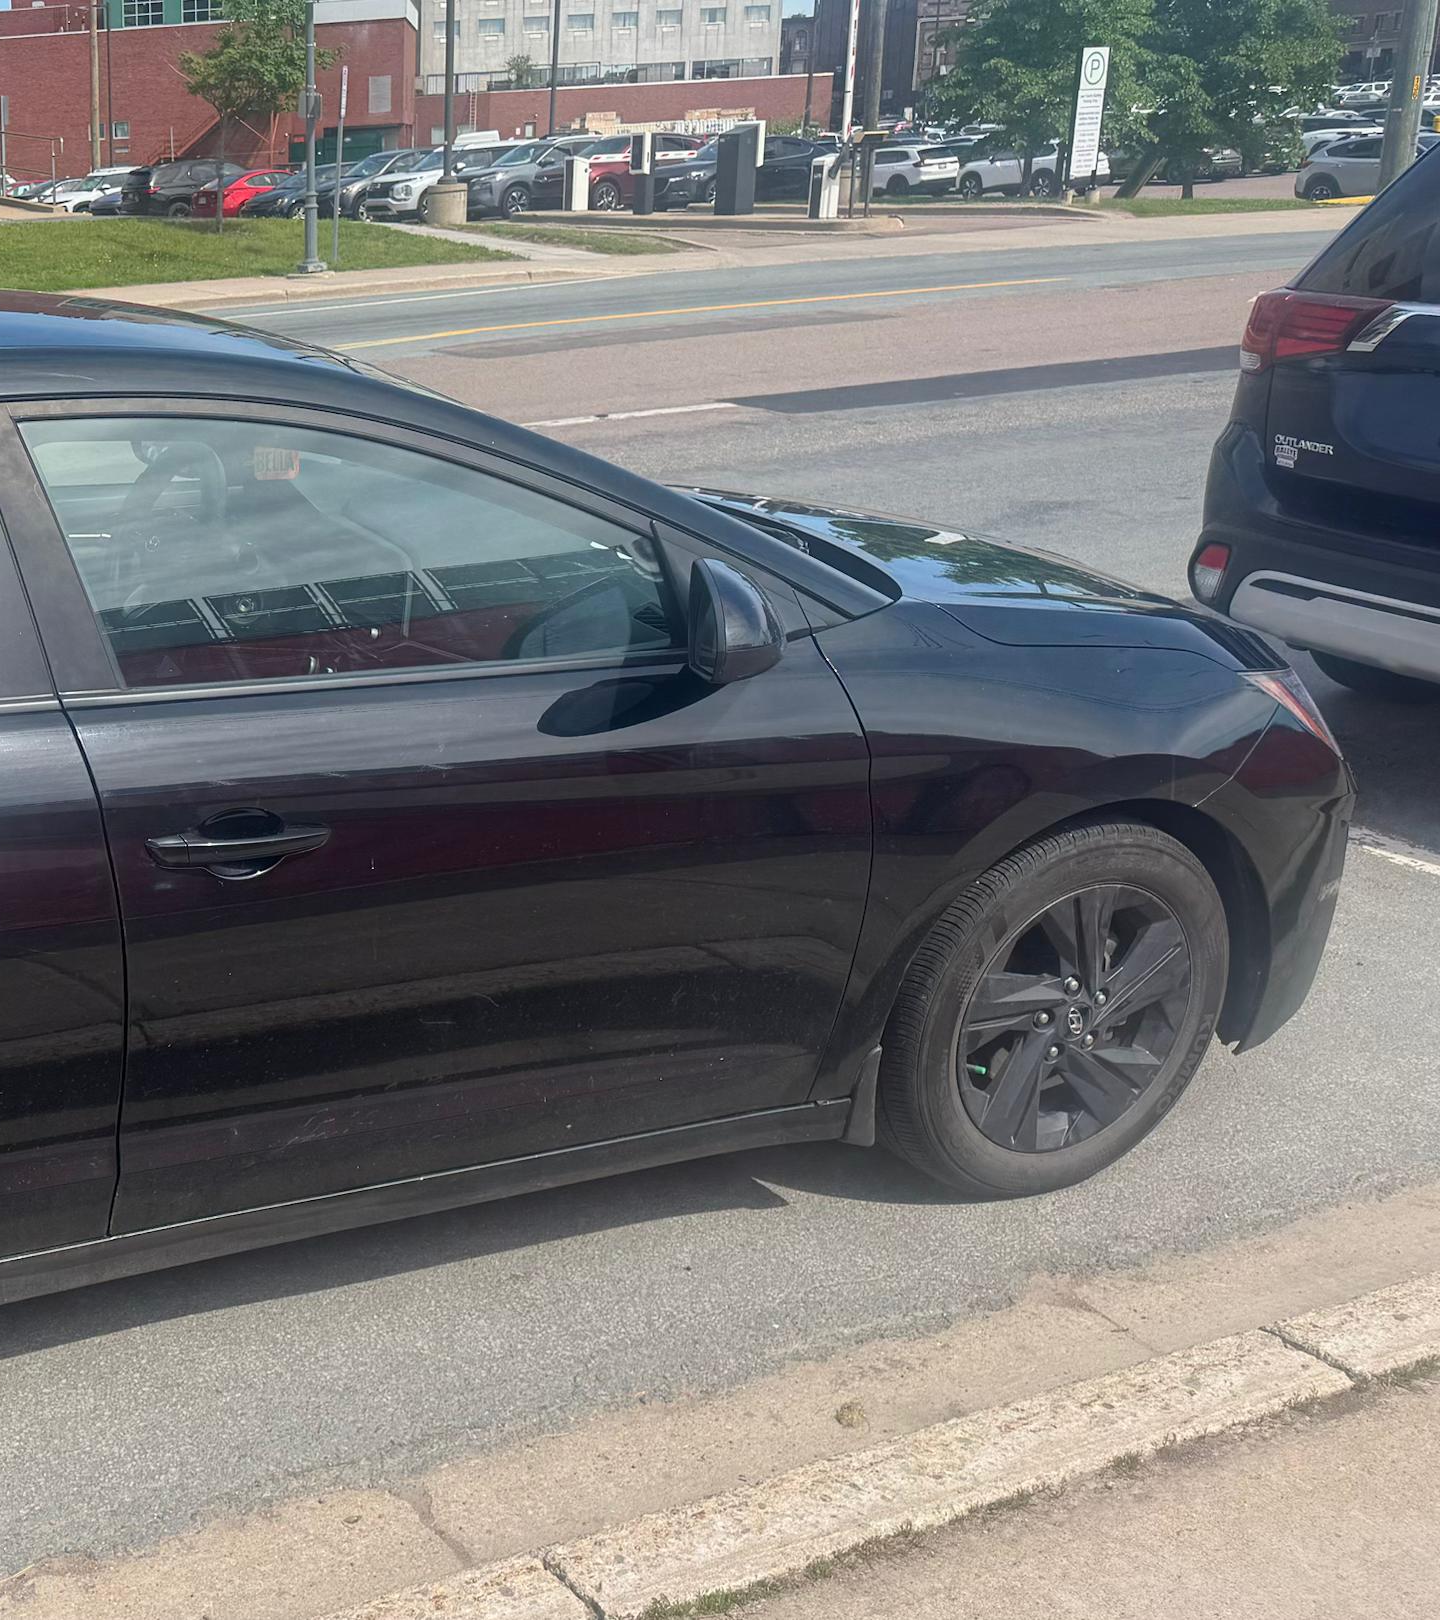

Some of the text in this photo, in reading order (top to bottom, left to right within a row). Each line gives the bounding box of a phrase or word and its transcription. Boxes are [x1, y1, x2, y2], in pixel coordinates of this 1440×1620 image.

[1090, 59, 1100, 78] P
[1274, 434, 1334, 455] OUTLANDER
[1157, 1013, 1215, 1112] KUMHO
